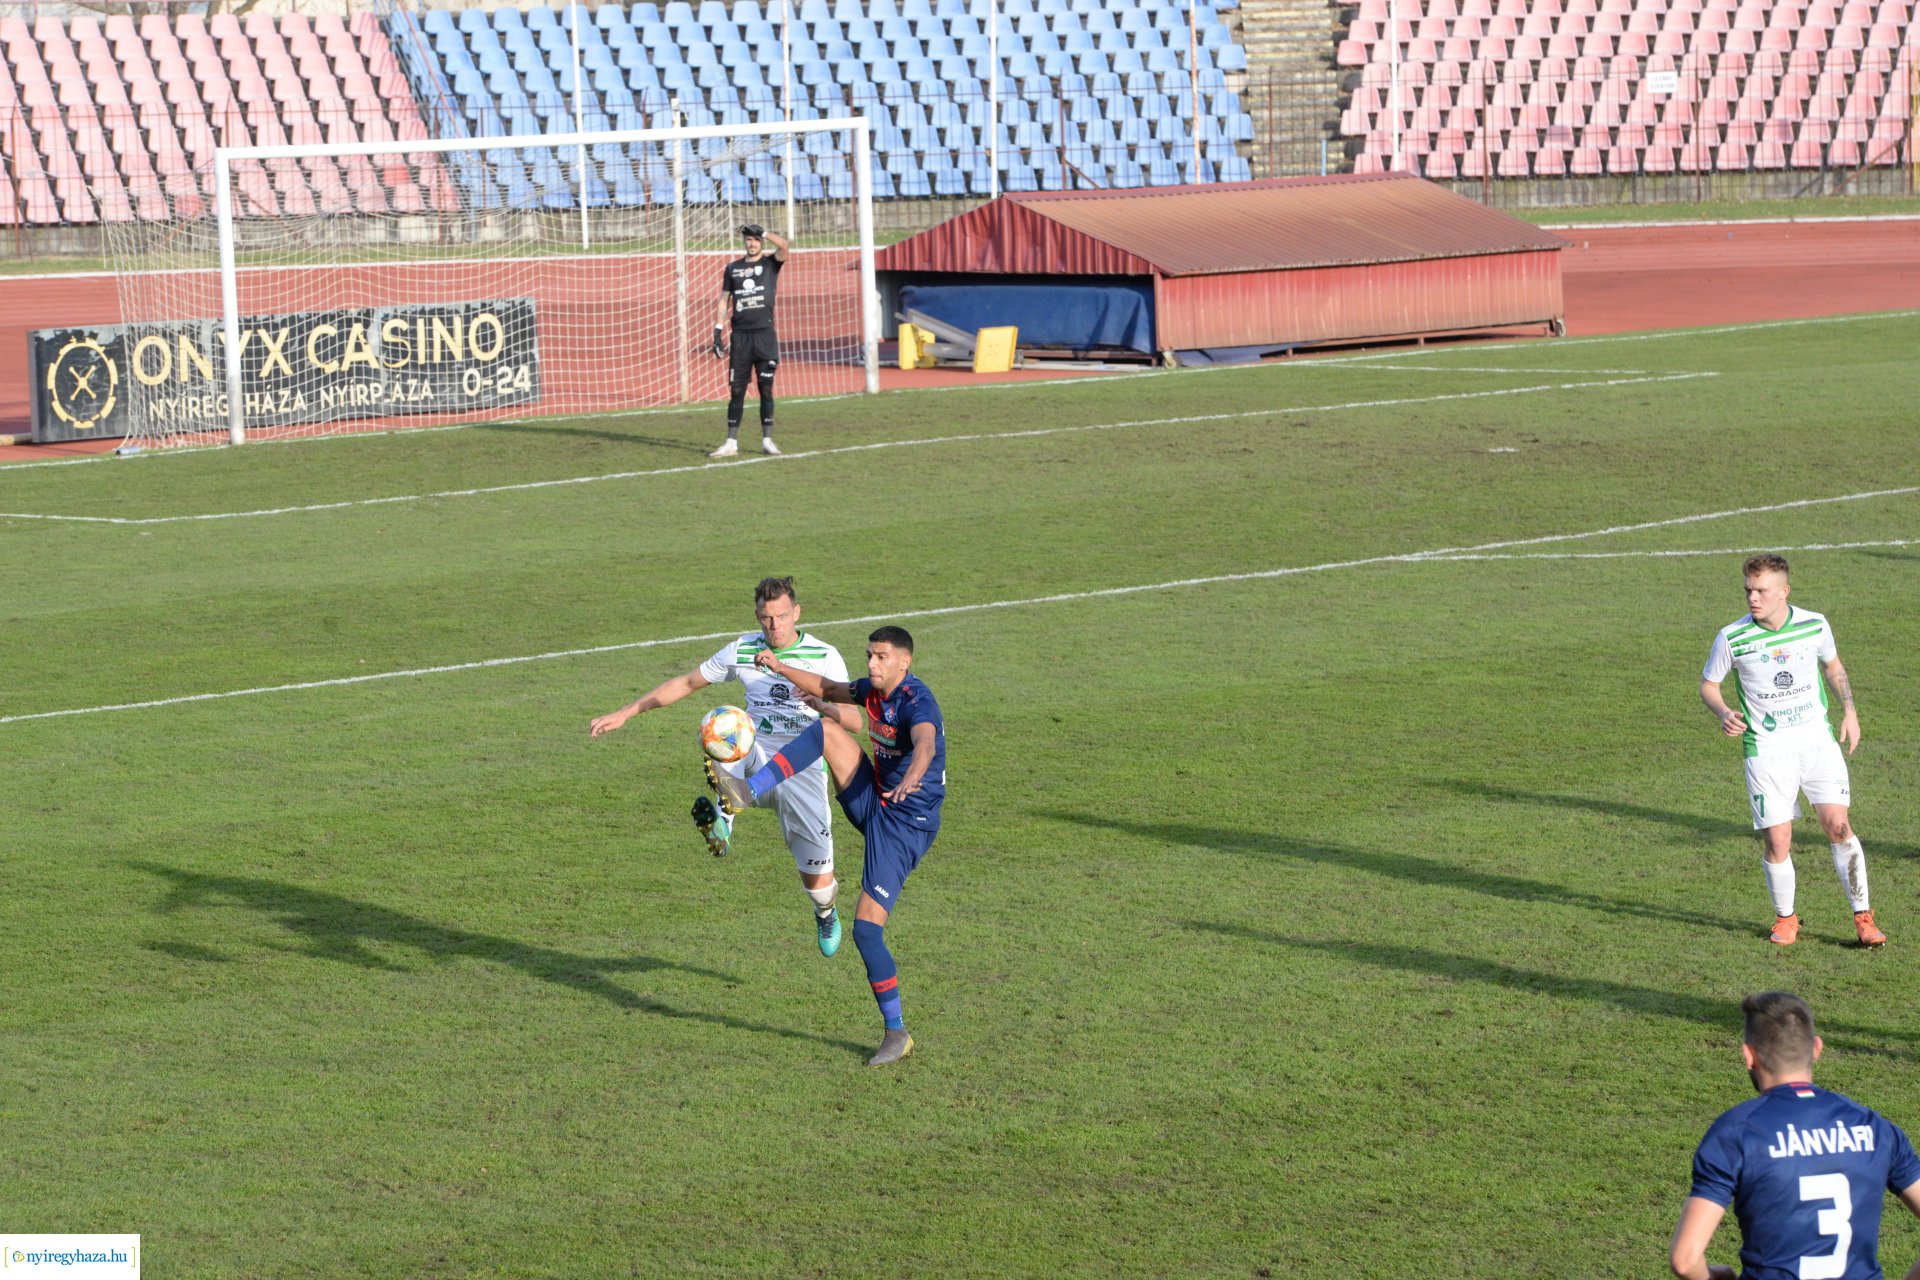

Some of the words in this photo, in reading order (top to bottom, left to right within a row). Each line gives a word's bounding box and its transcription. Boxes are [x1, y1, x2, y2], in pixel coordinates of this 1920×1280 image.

[307, 313, 505, 374] CASINO
[149, 384, 307, 421] NYÍREGHÁZA
[320, 374, 434, 409] NYÍRPÁZA
[462, 365, 531, 397] 0-24
[1757, 684, 1812, 700] SZABADICS
[1772, 708, 1793, 718] FINO
[1794, 701, 1813, 713] FRISS
[1753, 794, 1765, 819] 7
[806, 857, 831, 866] Zeus
[874, 884, 890, 899] JAKO
[1798, 1172, 1852, 1280] 3
